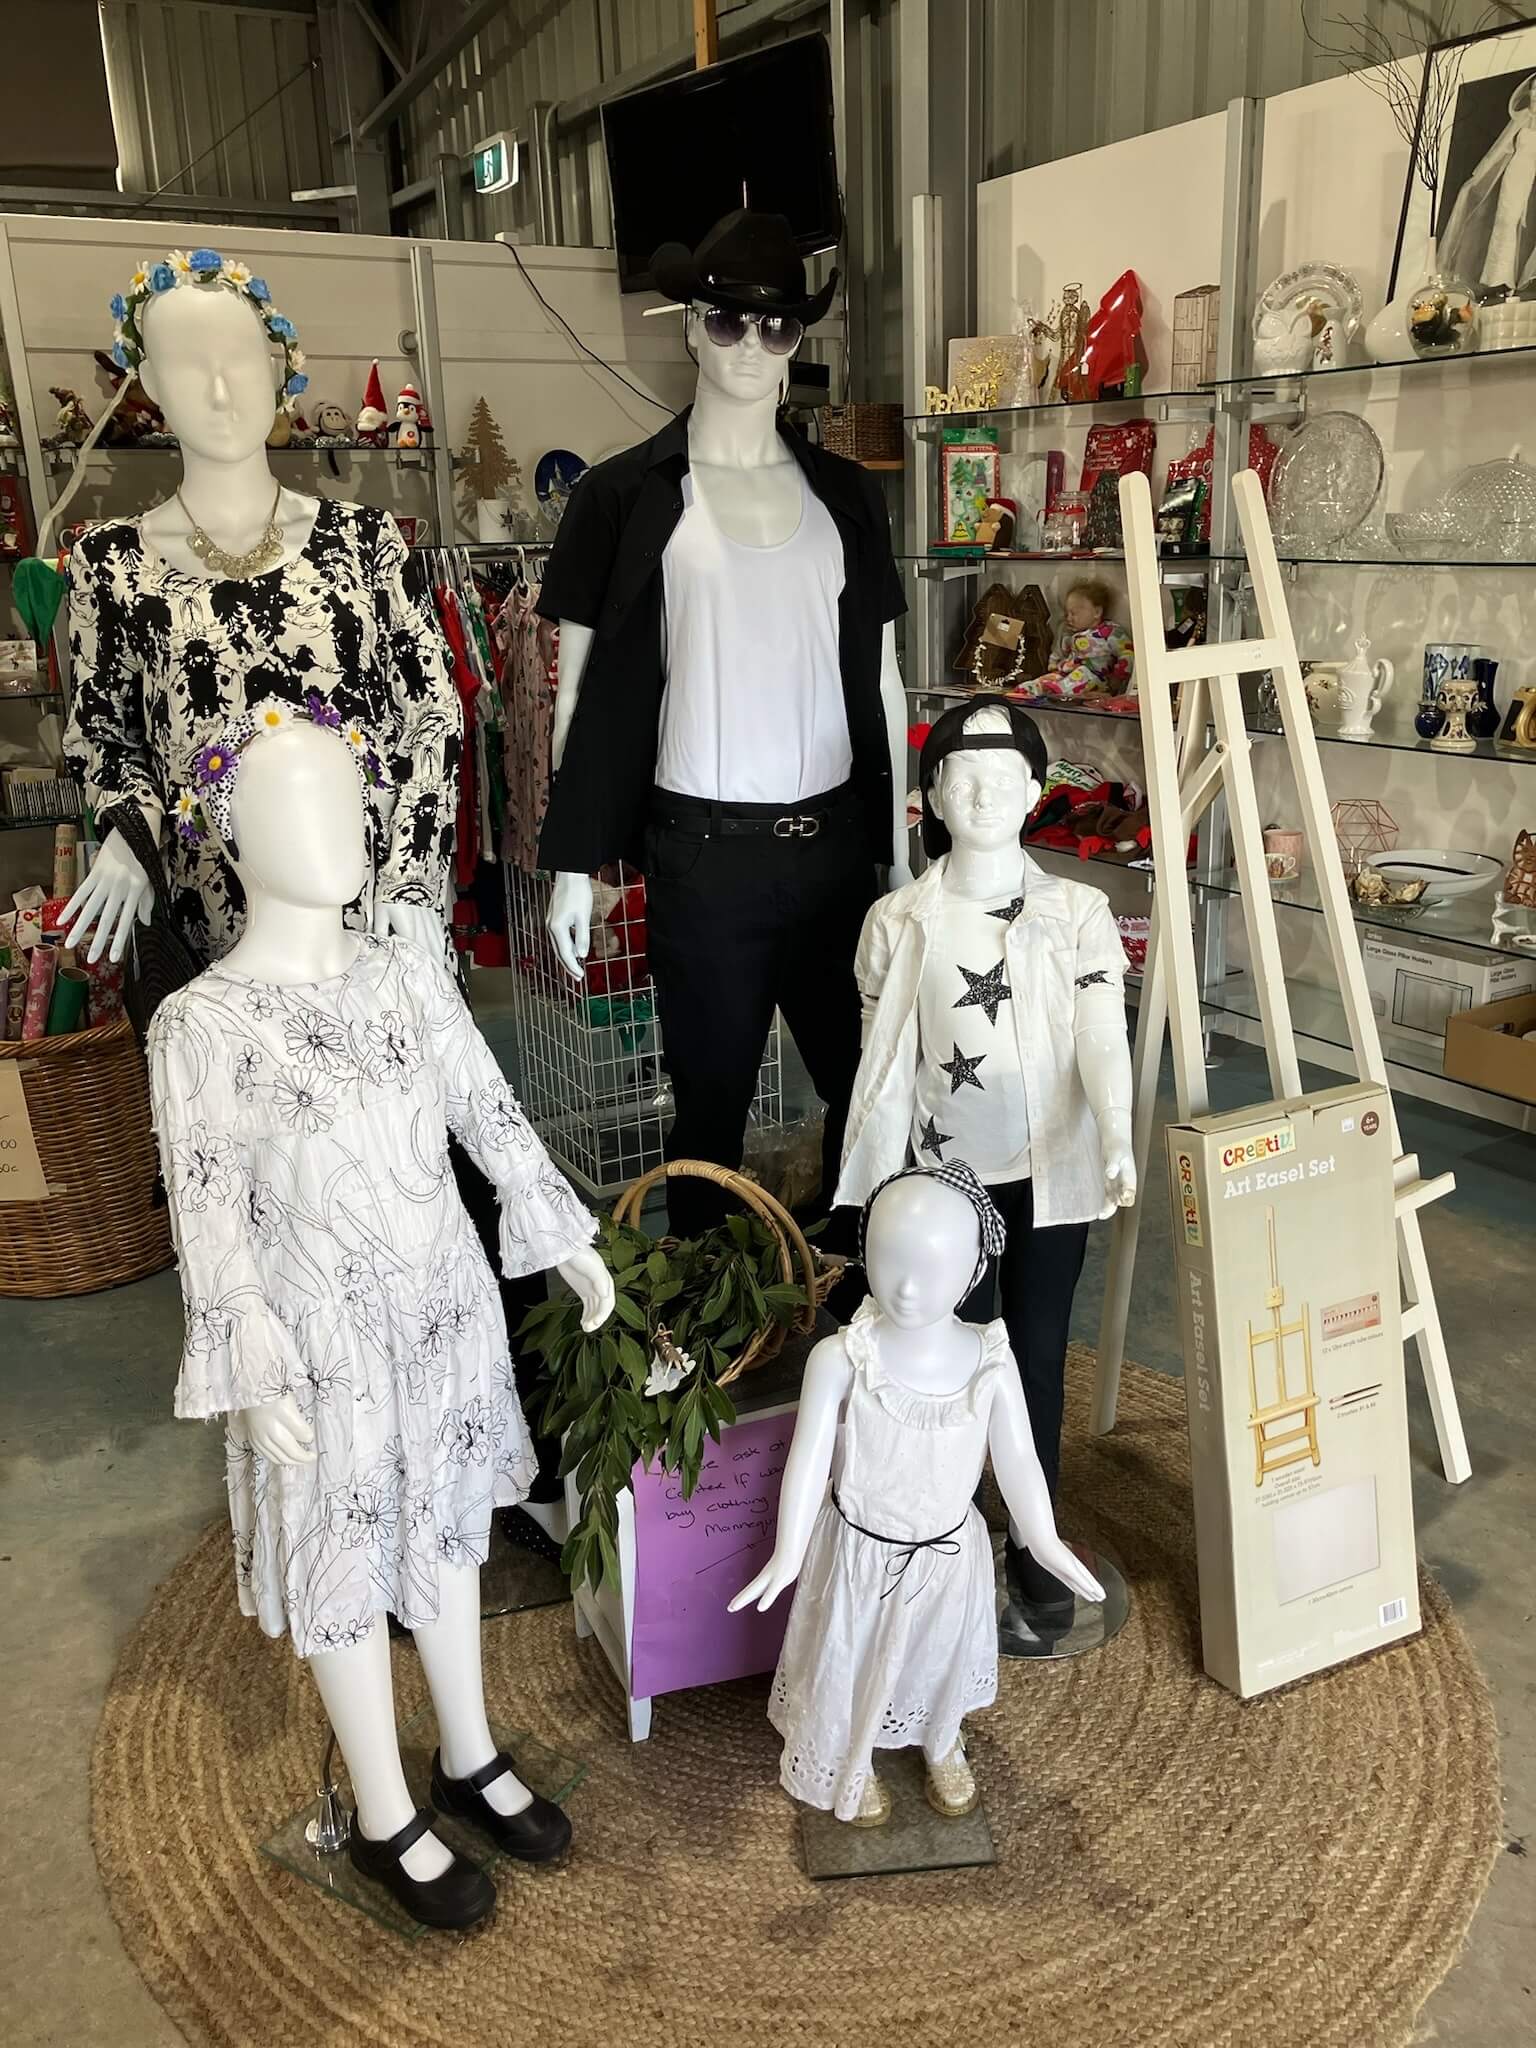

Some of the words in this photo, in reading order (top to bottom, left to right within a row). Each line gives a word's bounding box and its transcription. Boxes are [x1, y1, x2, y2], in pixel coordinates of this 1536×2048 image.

[1366, 944, 1381, 954] Large
[1224, 1175, 1251, 1199] Art
[1255, 1163, 1304, 1191] Easel
[1308, 1155, 1336, 1178] Set
[1190, 1271, 1203, 1307] Art
[1192, 1312, 1208, 1371] Easel
[1197, 1373, 1211, 1410] Set
[732, 1447, 760, 1461] ask
[665, 1509, 696, 1529] buy
